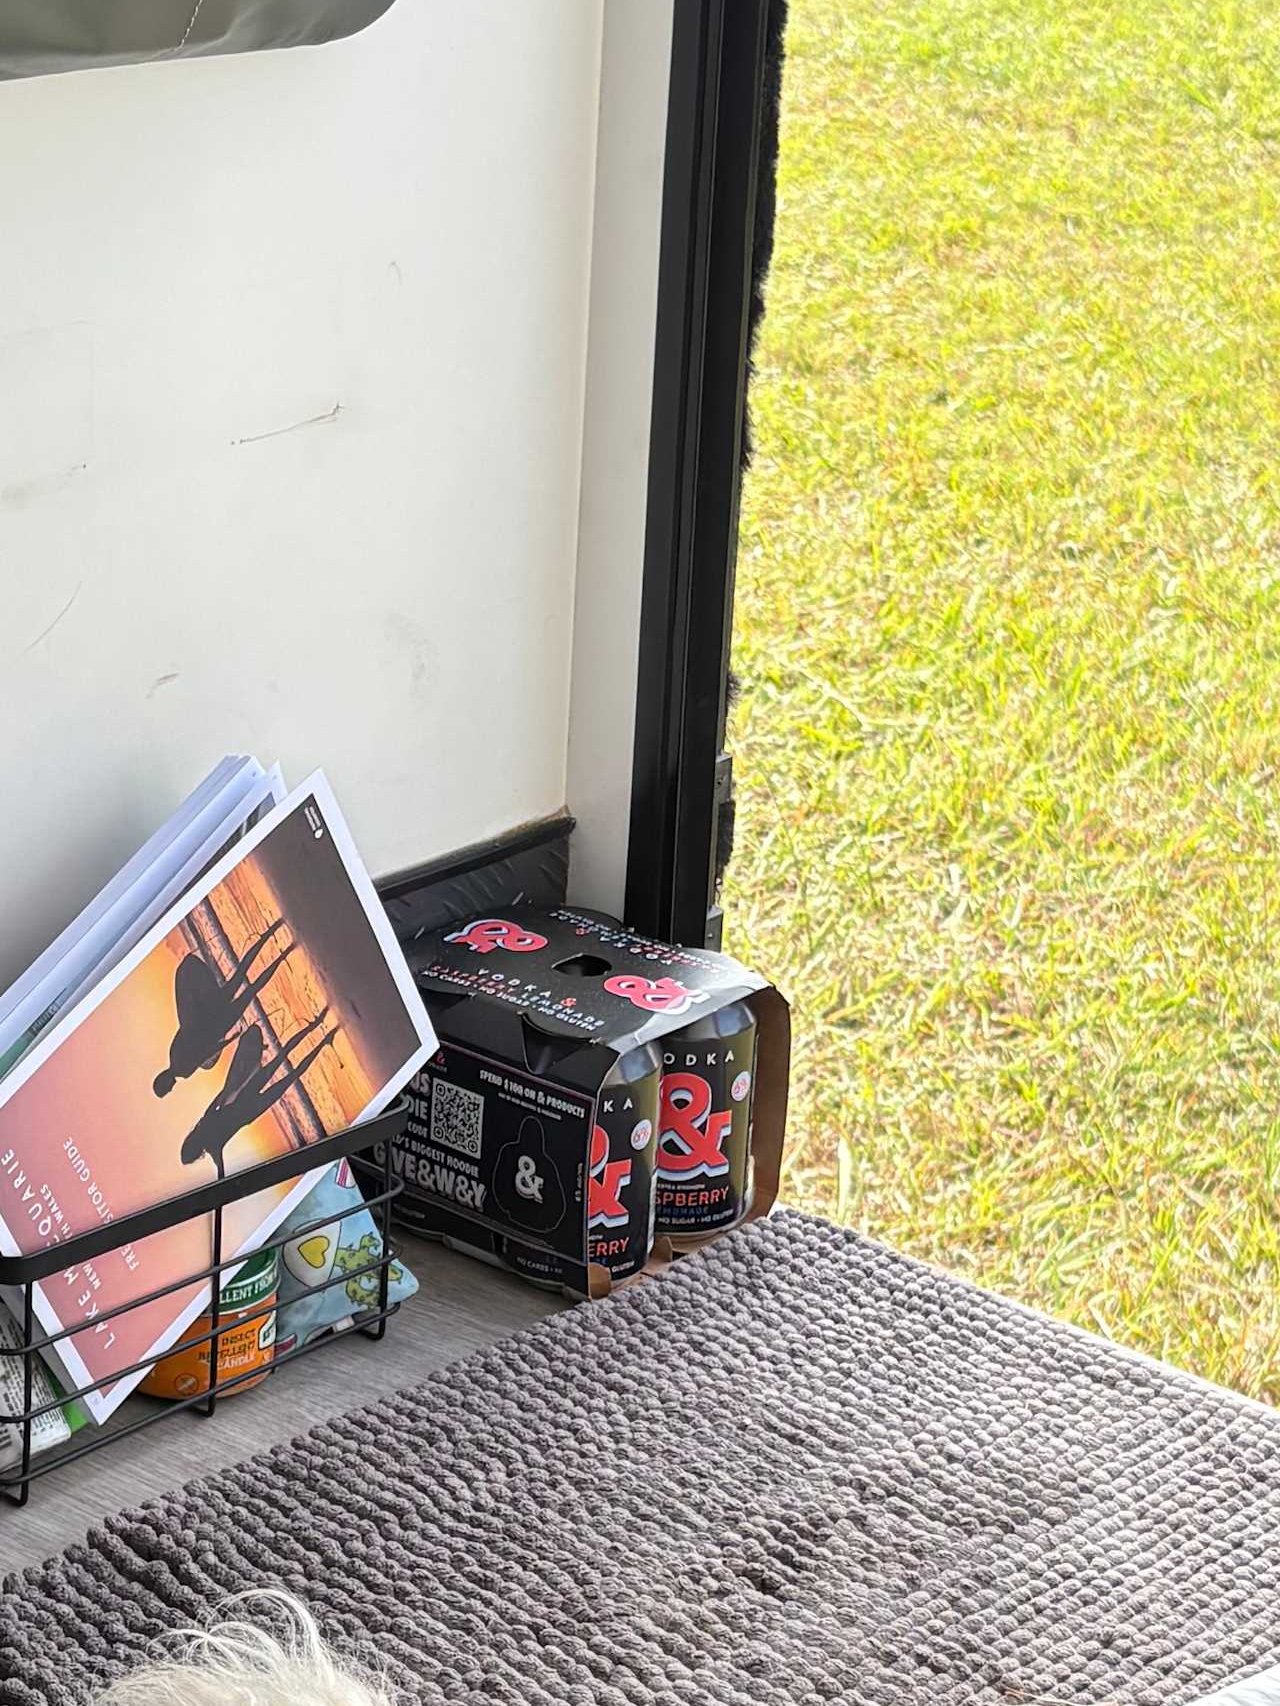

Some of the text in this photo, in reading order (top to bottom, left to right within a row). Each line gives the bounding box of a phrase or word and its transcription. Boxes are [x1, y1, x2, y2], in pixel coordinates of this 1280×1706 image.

[477, 968, 553, 998] VODKA
[662, 1050, 736, 1066] ODKA
[546, 1095, 586, 1119] PRODUCTS
[63, 1136, 91, 1182] GUIDE
[411, 1139, 446, 1163] BIGGEST
[373, 1142, 488, 1213] GVE&W&Y
[40, 1183, 64, 1224] WALES
[119, 1242, 141, 1272] FRE
[82, 1263, 102, 1290] NEW
[220, 1286, 253, 1304] LLENT
